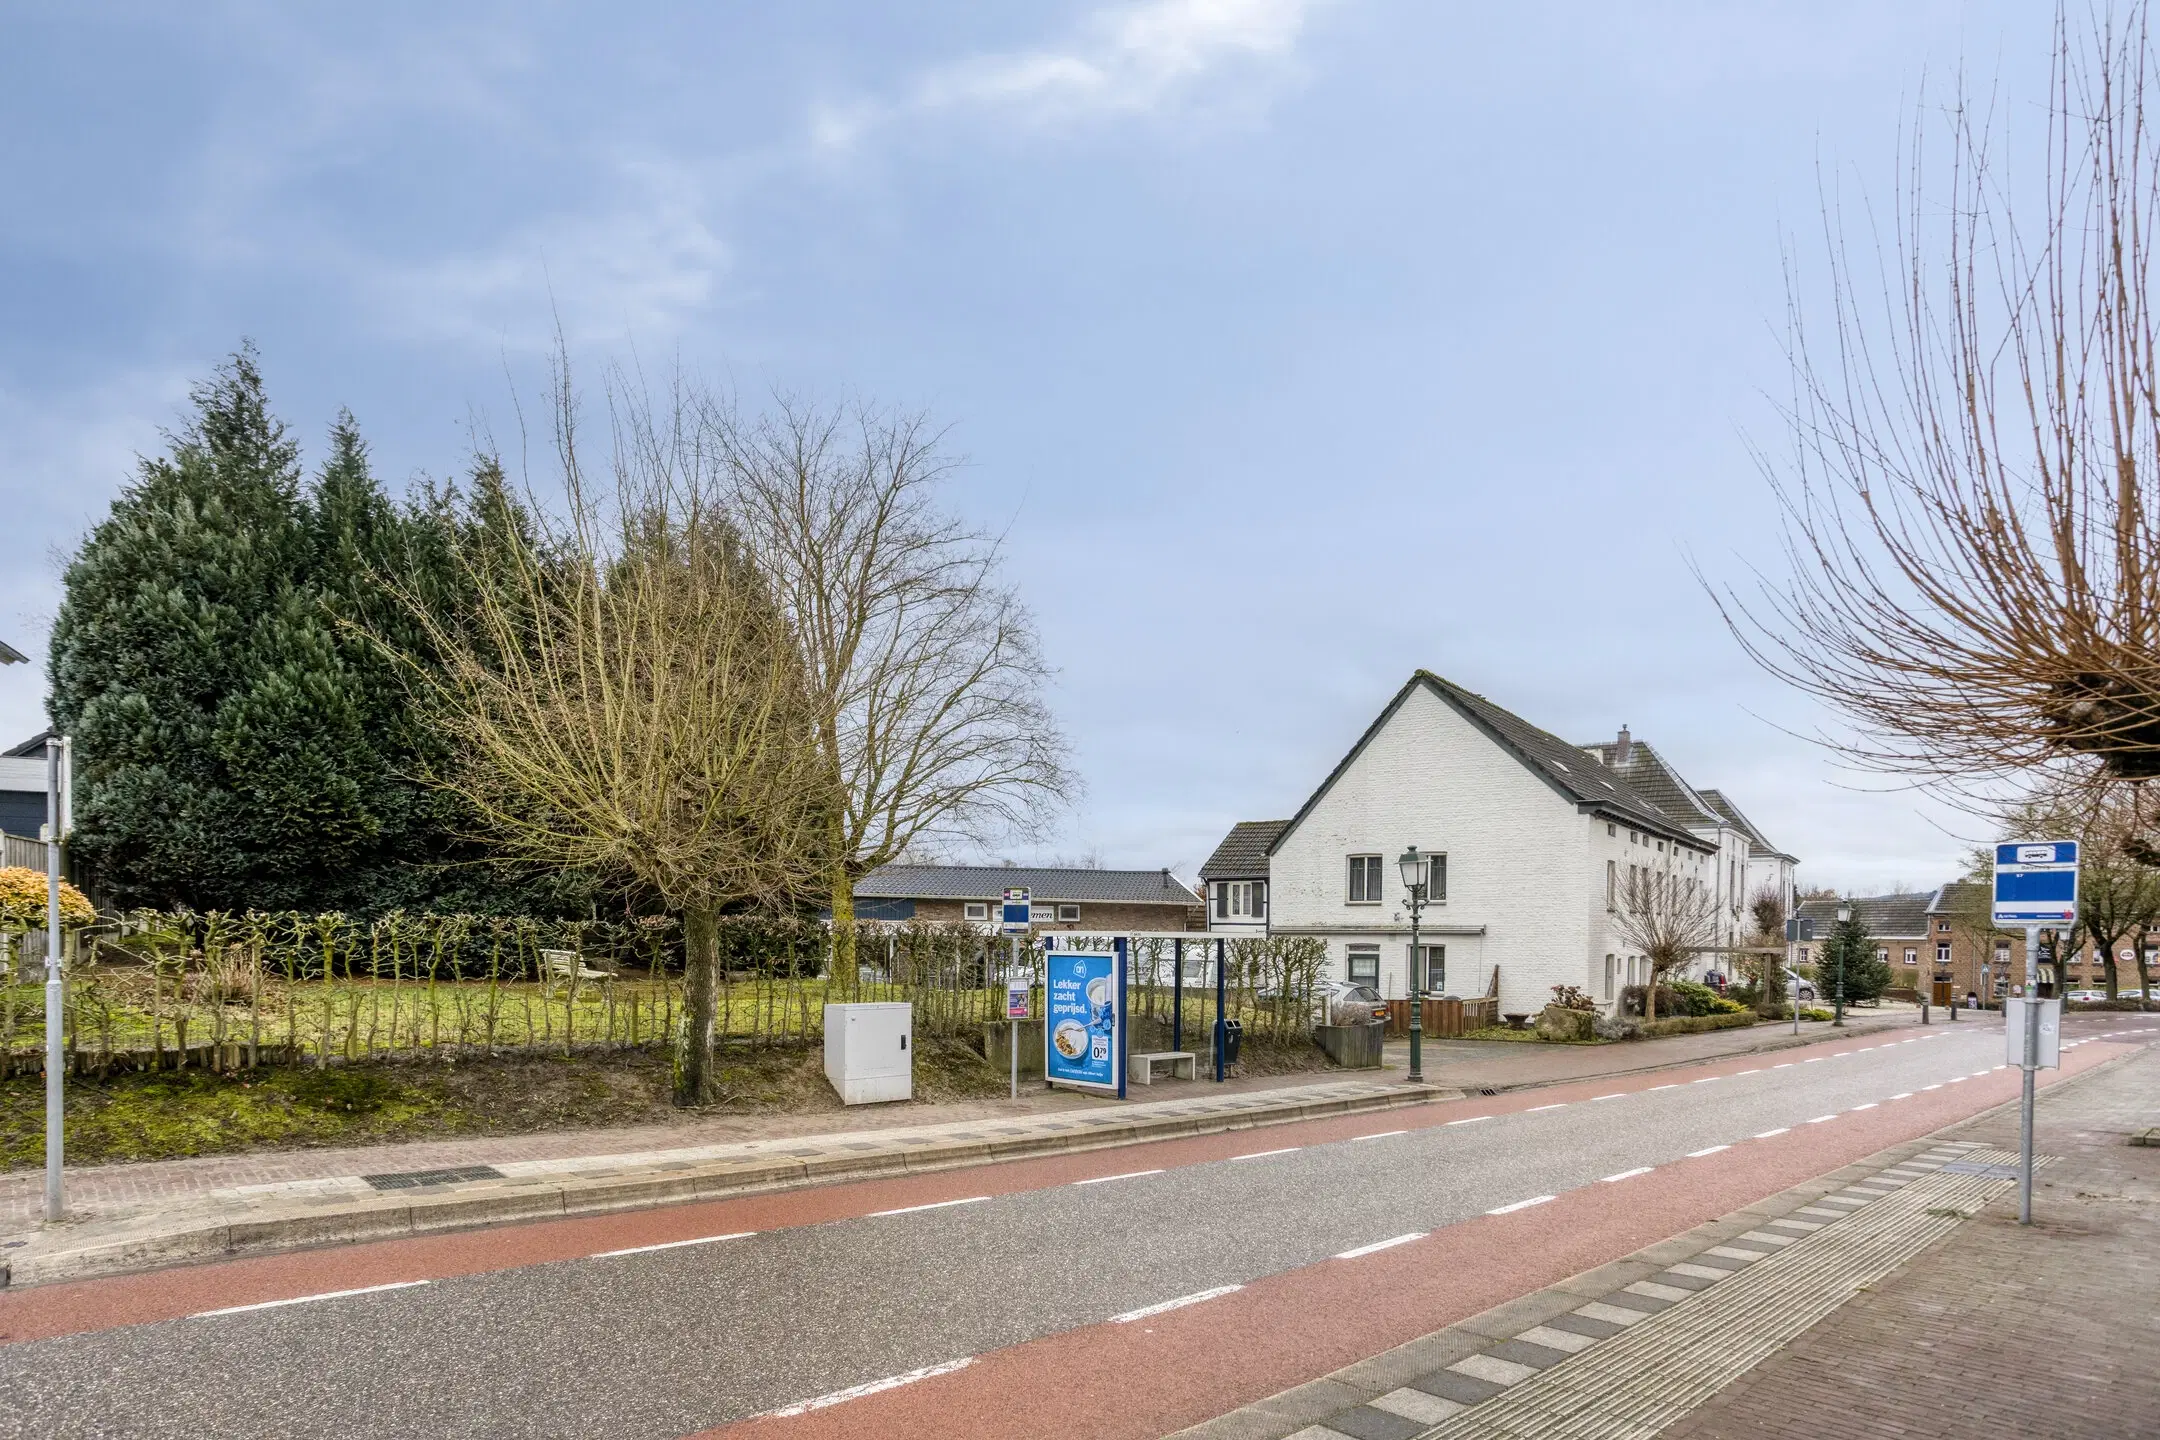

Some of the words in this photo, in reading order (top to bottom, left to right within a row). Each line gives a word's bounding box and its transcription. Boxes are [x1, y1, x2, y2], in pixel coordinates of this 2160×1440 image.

[1054, 980, 1082, 990] Lekker
[1054, 992, 1076, 1001] zacht
[1054, 1003, 1088, 1014] geprijsd.
